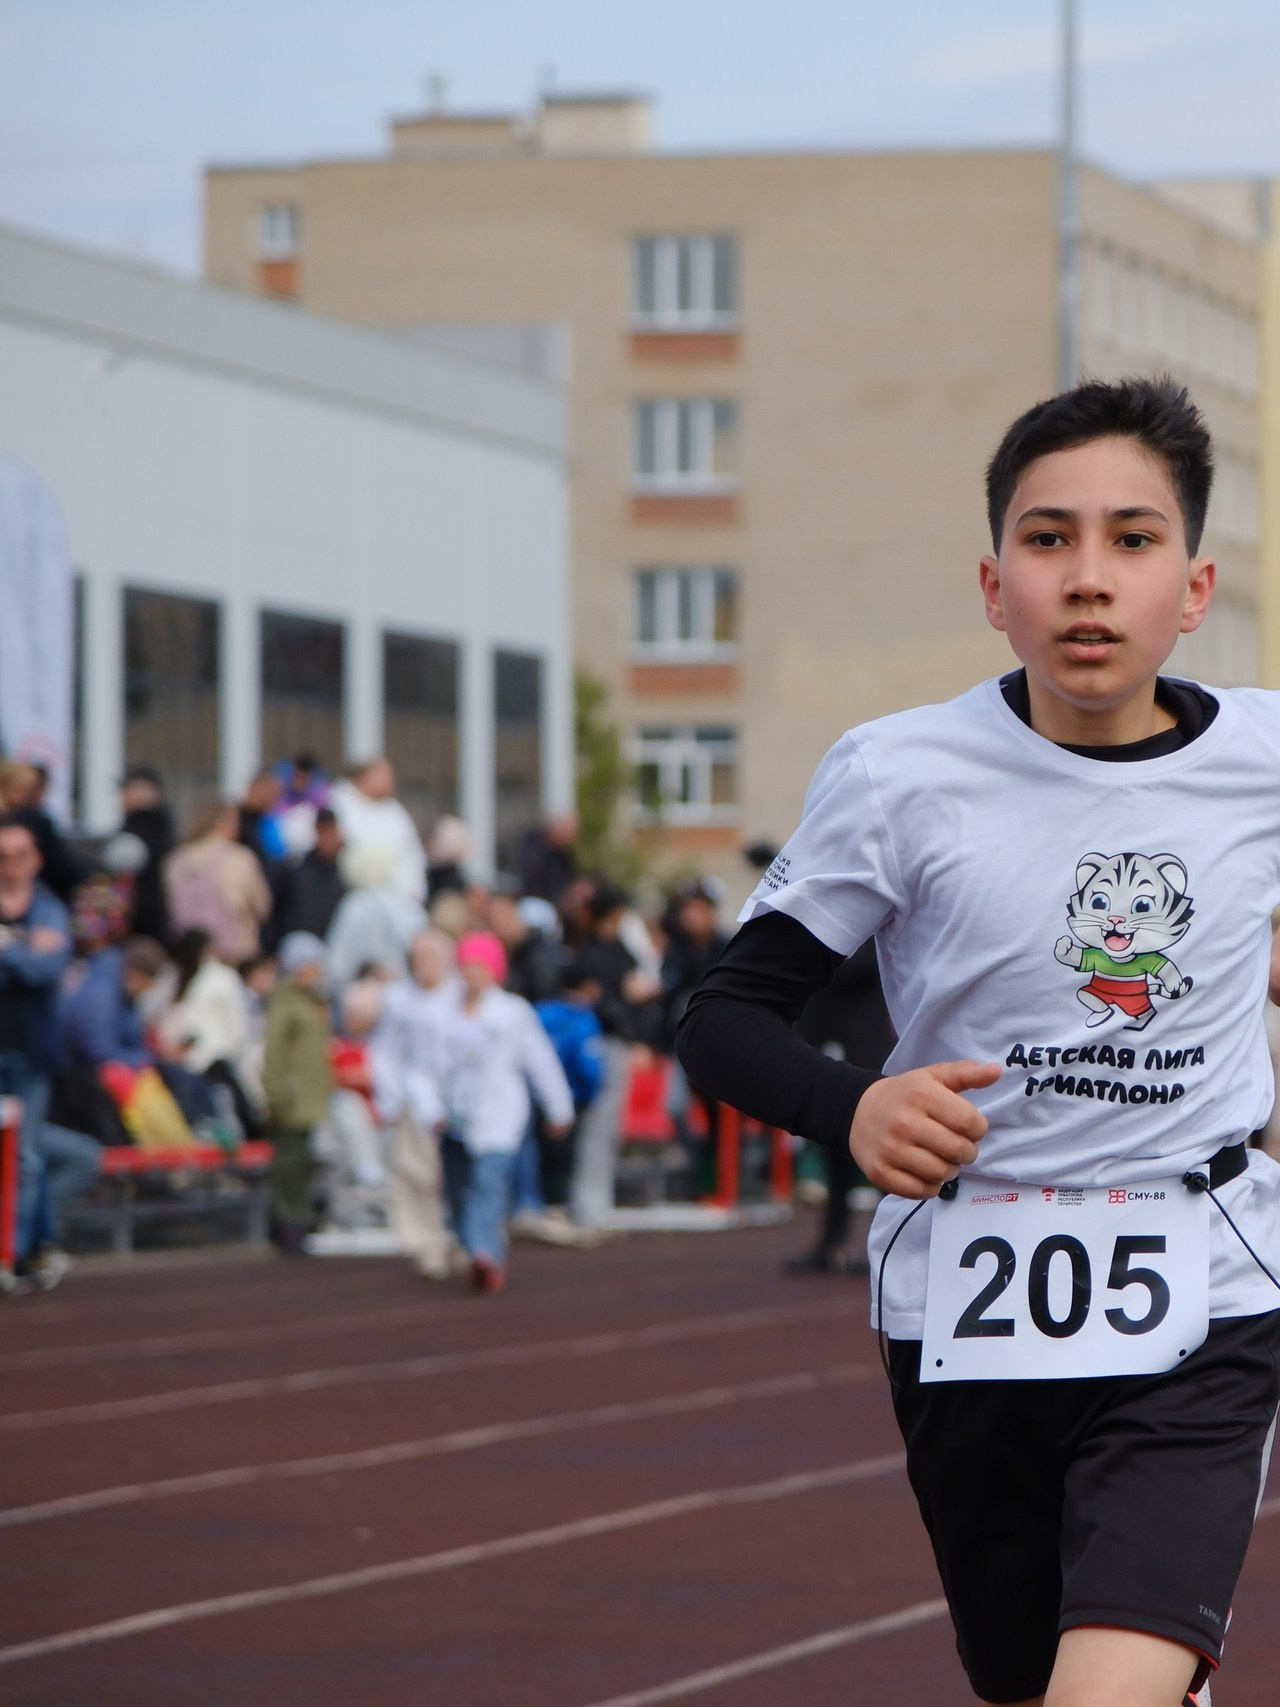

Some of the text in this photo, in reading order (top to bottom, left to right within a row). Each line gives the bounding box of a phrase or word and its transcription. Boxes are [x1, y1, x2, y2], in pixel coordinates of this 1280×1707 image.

[1005, 1043, 1205, 1070] ДЕТСКАЯ ЛИГА
[1025, 1074, 1185, 1105] ТРИАТЛОНА
[971, 1194, 1018, 1204] МИНСПОРТ
[1127, 1191, 1166, 1202] СМУ-88
[953, 1233, 1171, 1339] 205
